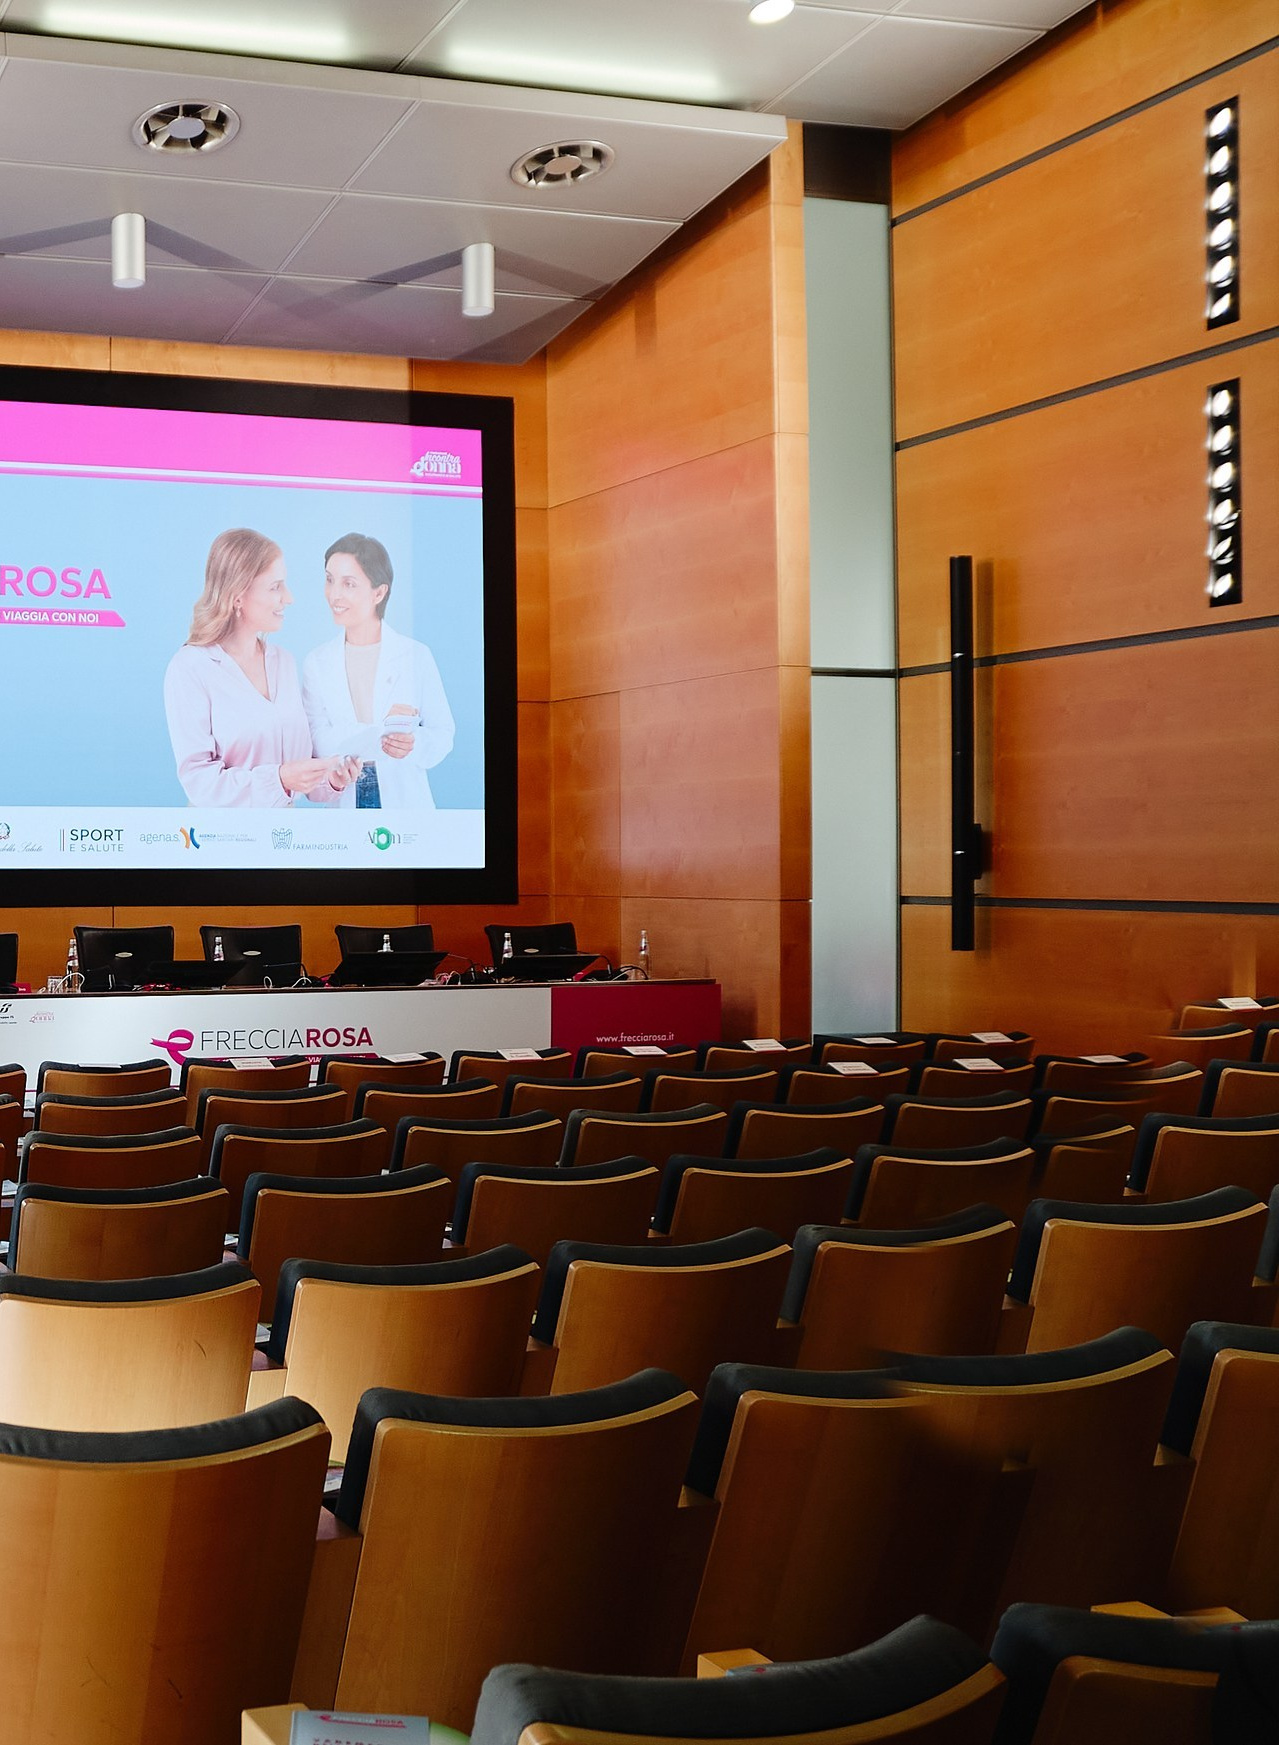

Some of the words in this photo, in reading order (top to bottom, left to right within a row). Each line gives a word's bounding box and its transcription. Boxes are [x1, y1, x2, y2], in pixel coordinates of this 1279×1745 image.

[3, 610, 50, 623] VIAGGIA
[51, 612, 76, 623] CON
[78, 612, 100, 624] NOI
[69, 828, 125, 842] SPORT
[69, 843, 76, 852] E
[80, 843, 125, 852] SALUTE
[292, 843, 349, 851] FARMINDUSTRIA
[200, 1026, 373, 1051] FRECCIAROSA
[596, 1032, 675, 1043] www.frecciarosa.it
